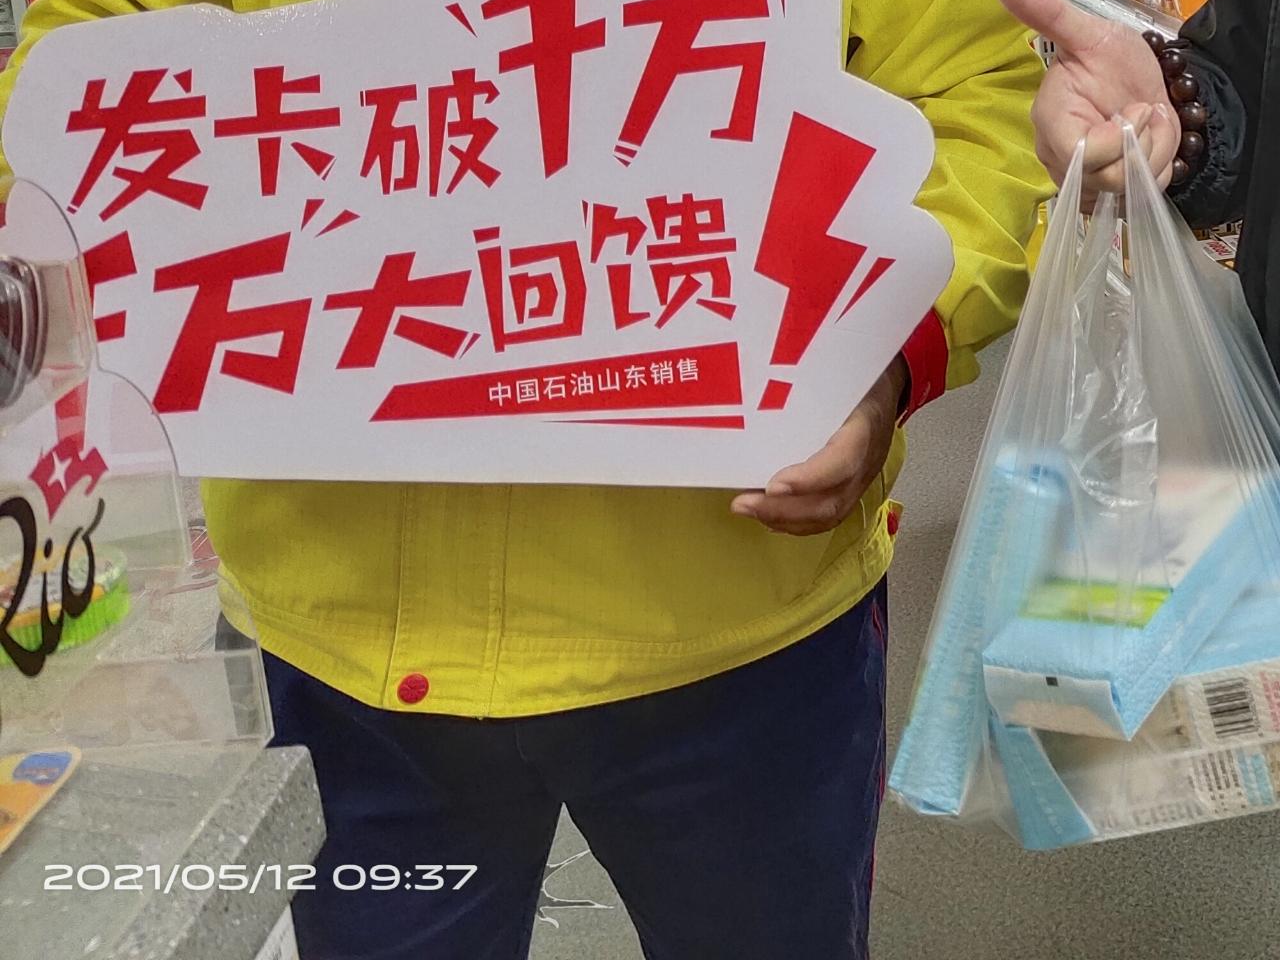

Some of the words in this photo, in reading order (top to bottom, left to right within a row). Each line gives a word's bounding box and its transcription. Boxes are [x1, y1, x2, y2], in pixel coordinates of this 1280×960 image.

[487, 357, 700, 407] 中国石油山东销售
